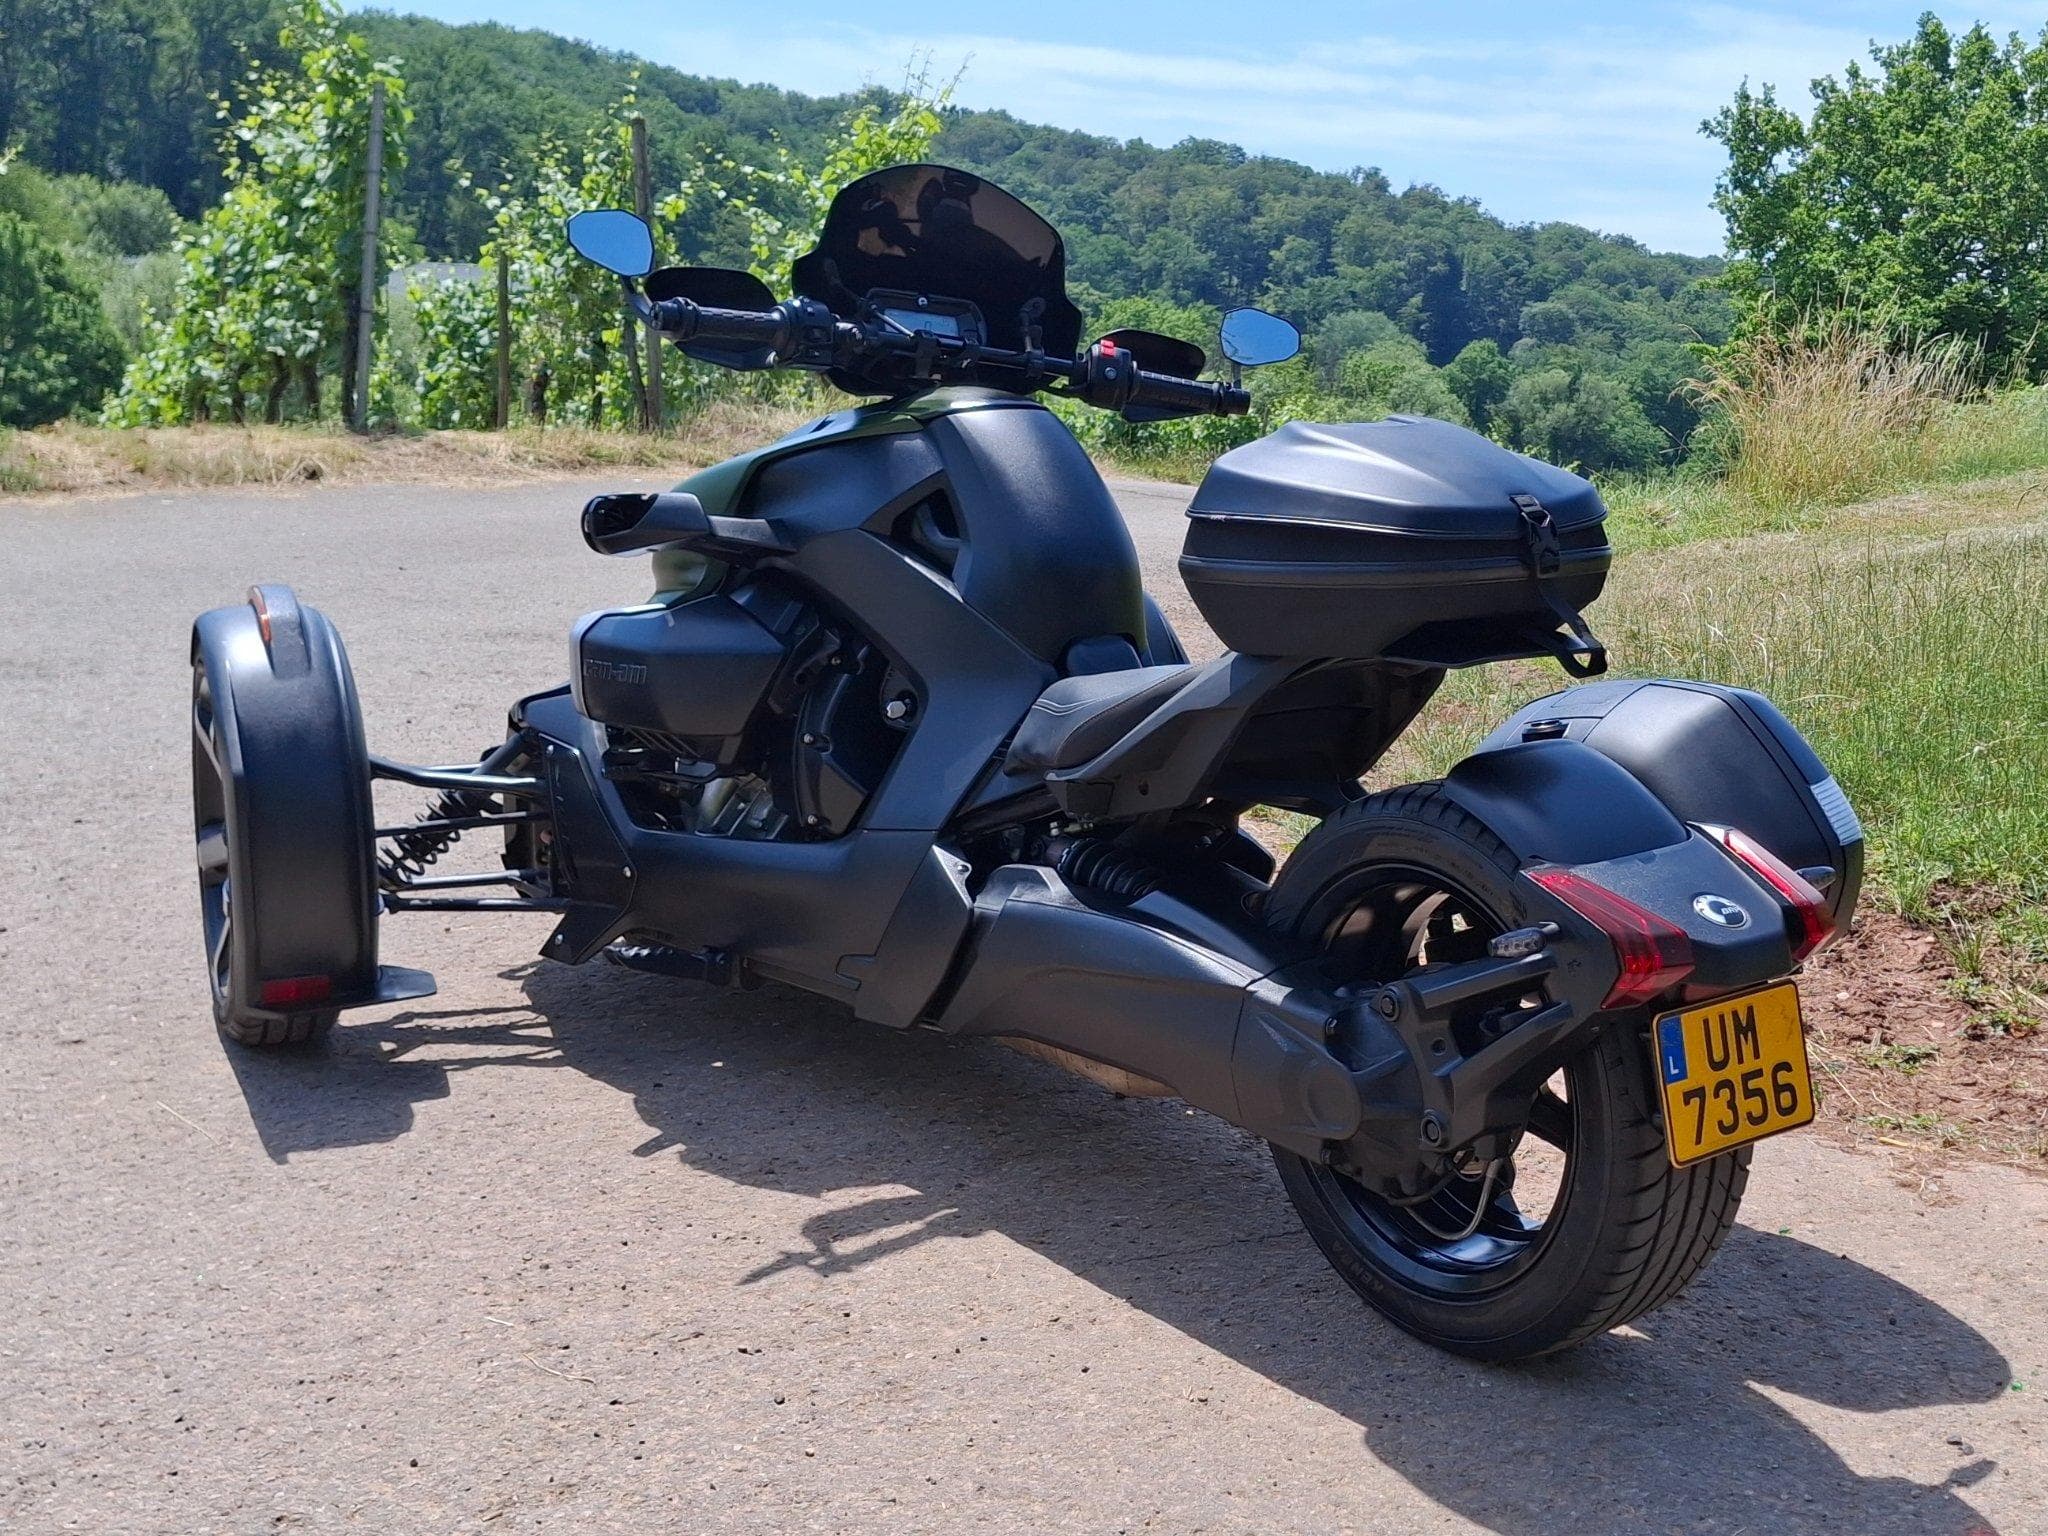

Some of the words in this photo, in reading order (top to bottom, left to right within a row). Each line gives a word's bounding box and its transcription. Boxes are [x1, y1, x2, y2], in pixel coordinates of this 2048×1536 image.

[1668, 1056, 1680, 1075] L
[1702, 1005, 1761, 1072] UM
[1682, 1061, 1799, 1146] 7356
